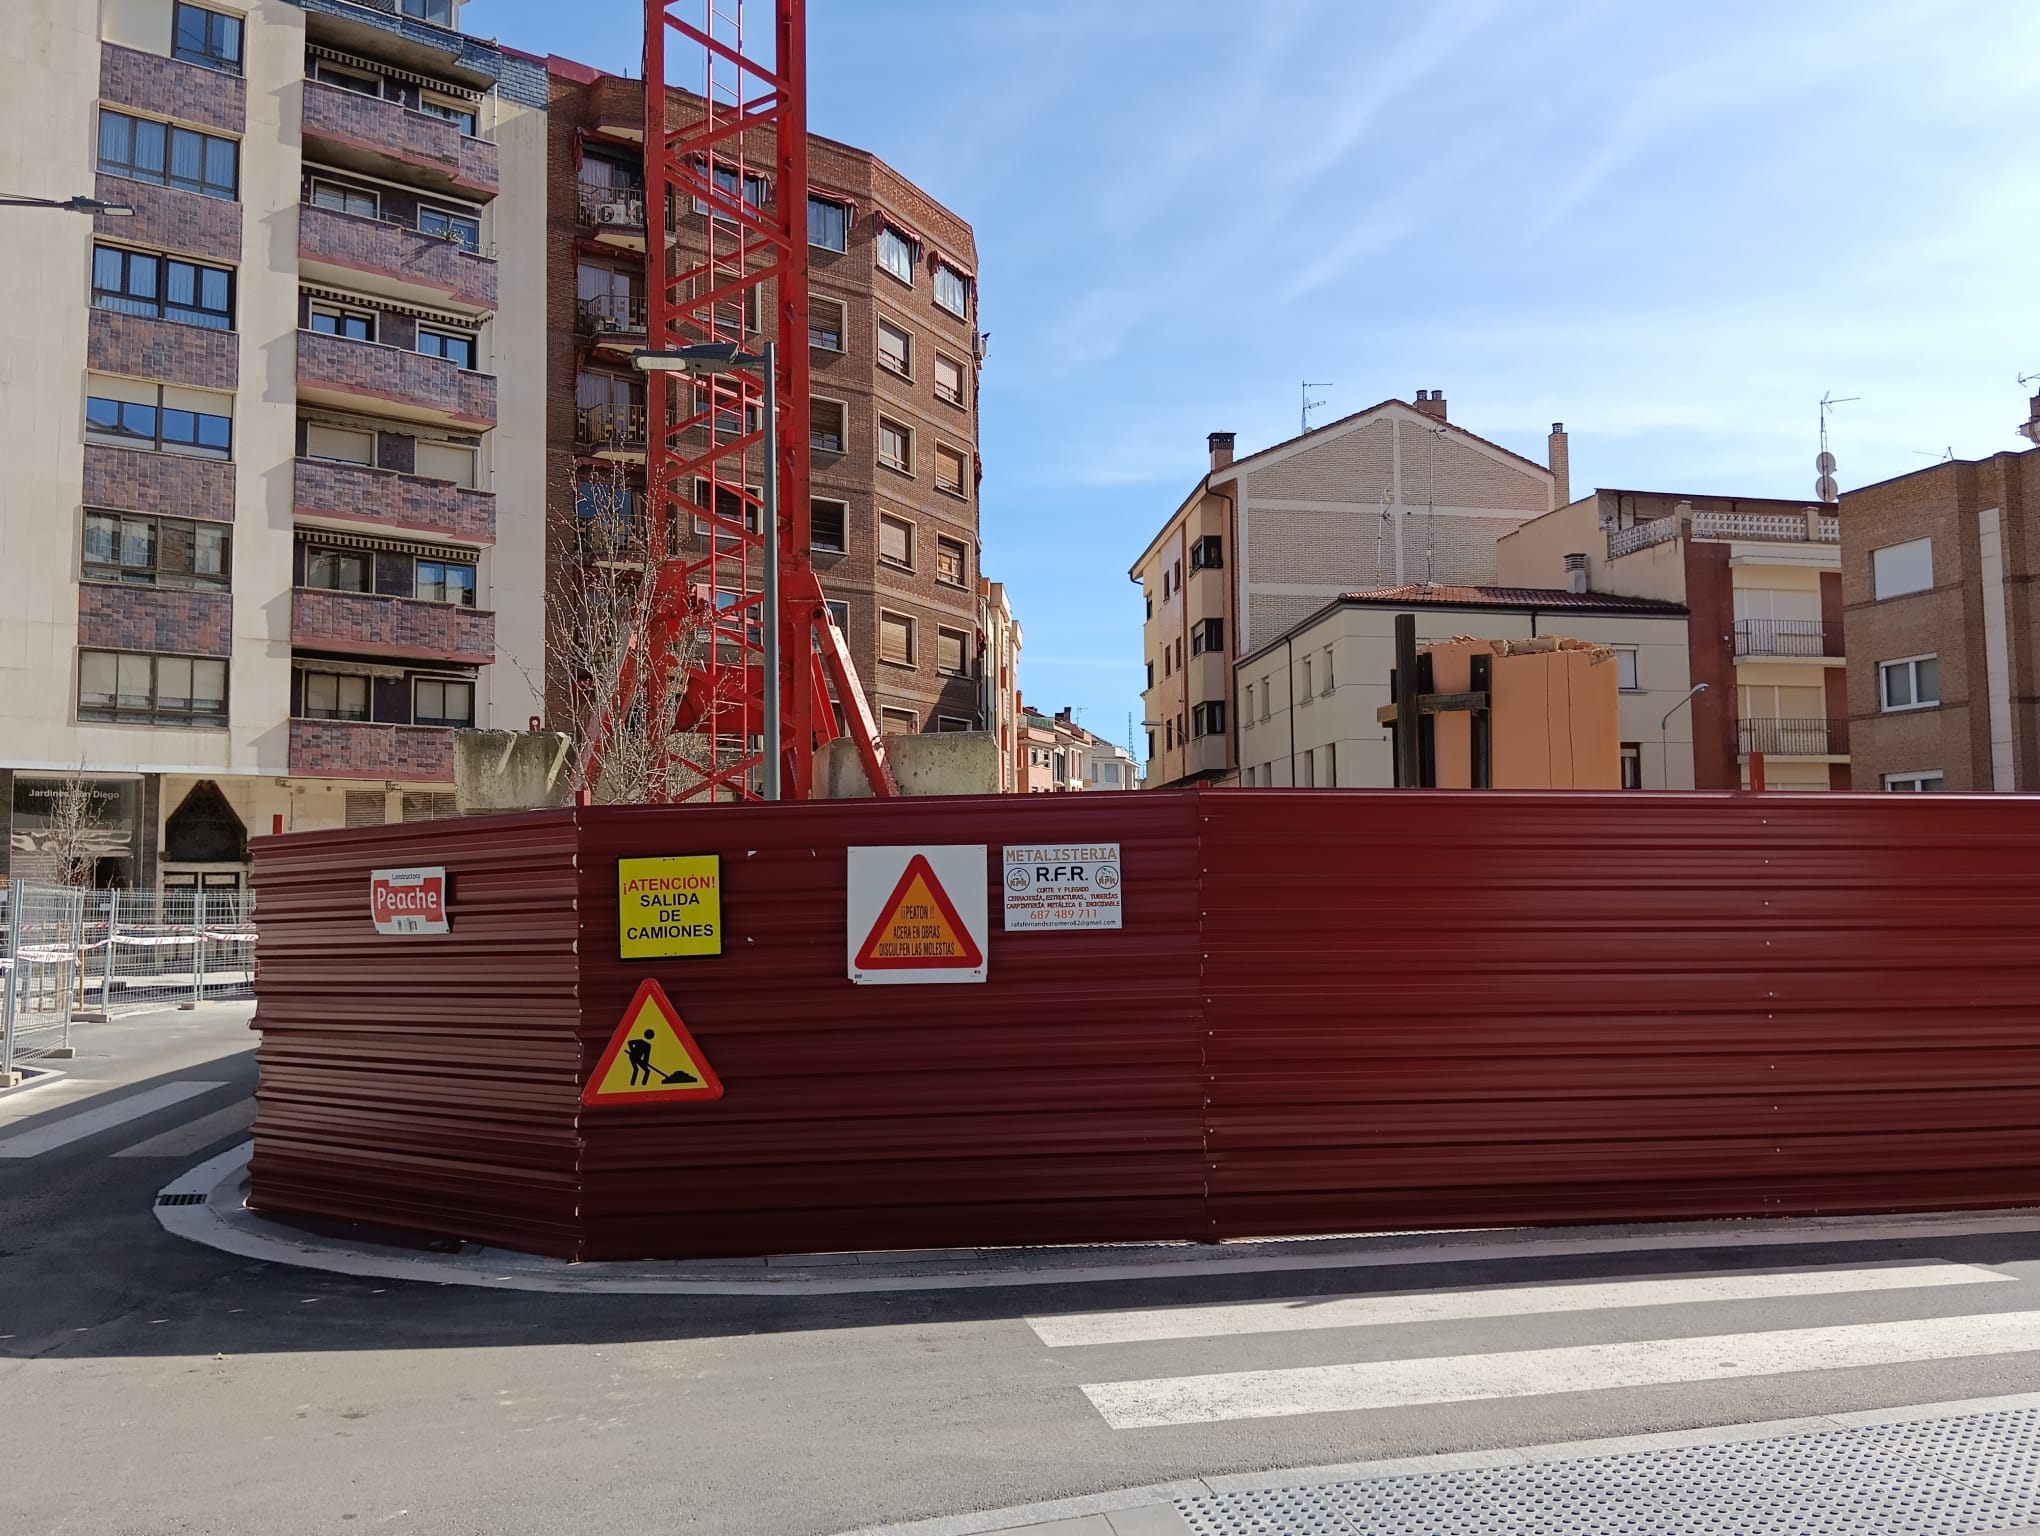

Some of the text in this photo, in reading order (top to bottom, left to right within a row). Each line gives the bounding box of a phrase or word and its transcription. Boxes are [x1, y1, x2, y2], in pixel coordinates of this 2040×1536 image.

[93, 790, 120, 800] Diego
[1006, 847, 1118, 862] METALISTERIA
[1036, 866, 1089, 882] R.F.R.
[623, 874, 716, 895] ¡ATENCIÓN!
[377, 887, 437, 910] Peache
[640, 893, 700, 907] SALIDA
[659, 910, 681, 922] DE
[1030, 909, 1097, 919] 687 489 711
[627, 924, 714, 940] CAMIONES
[893, 925, 940, 939] ACERA EN OBRAS
[879, 942, 955, 956] DISCULPEN LAS MOLESTIAS
